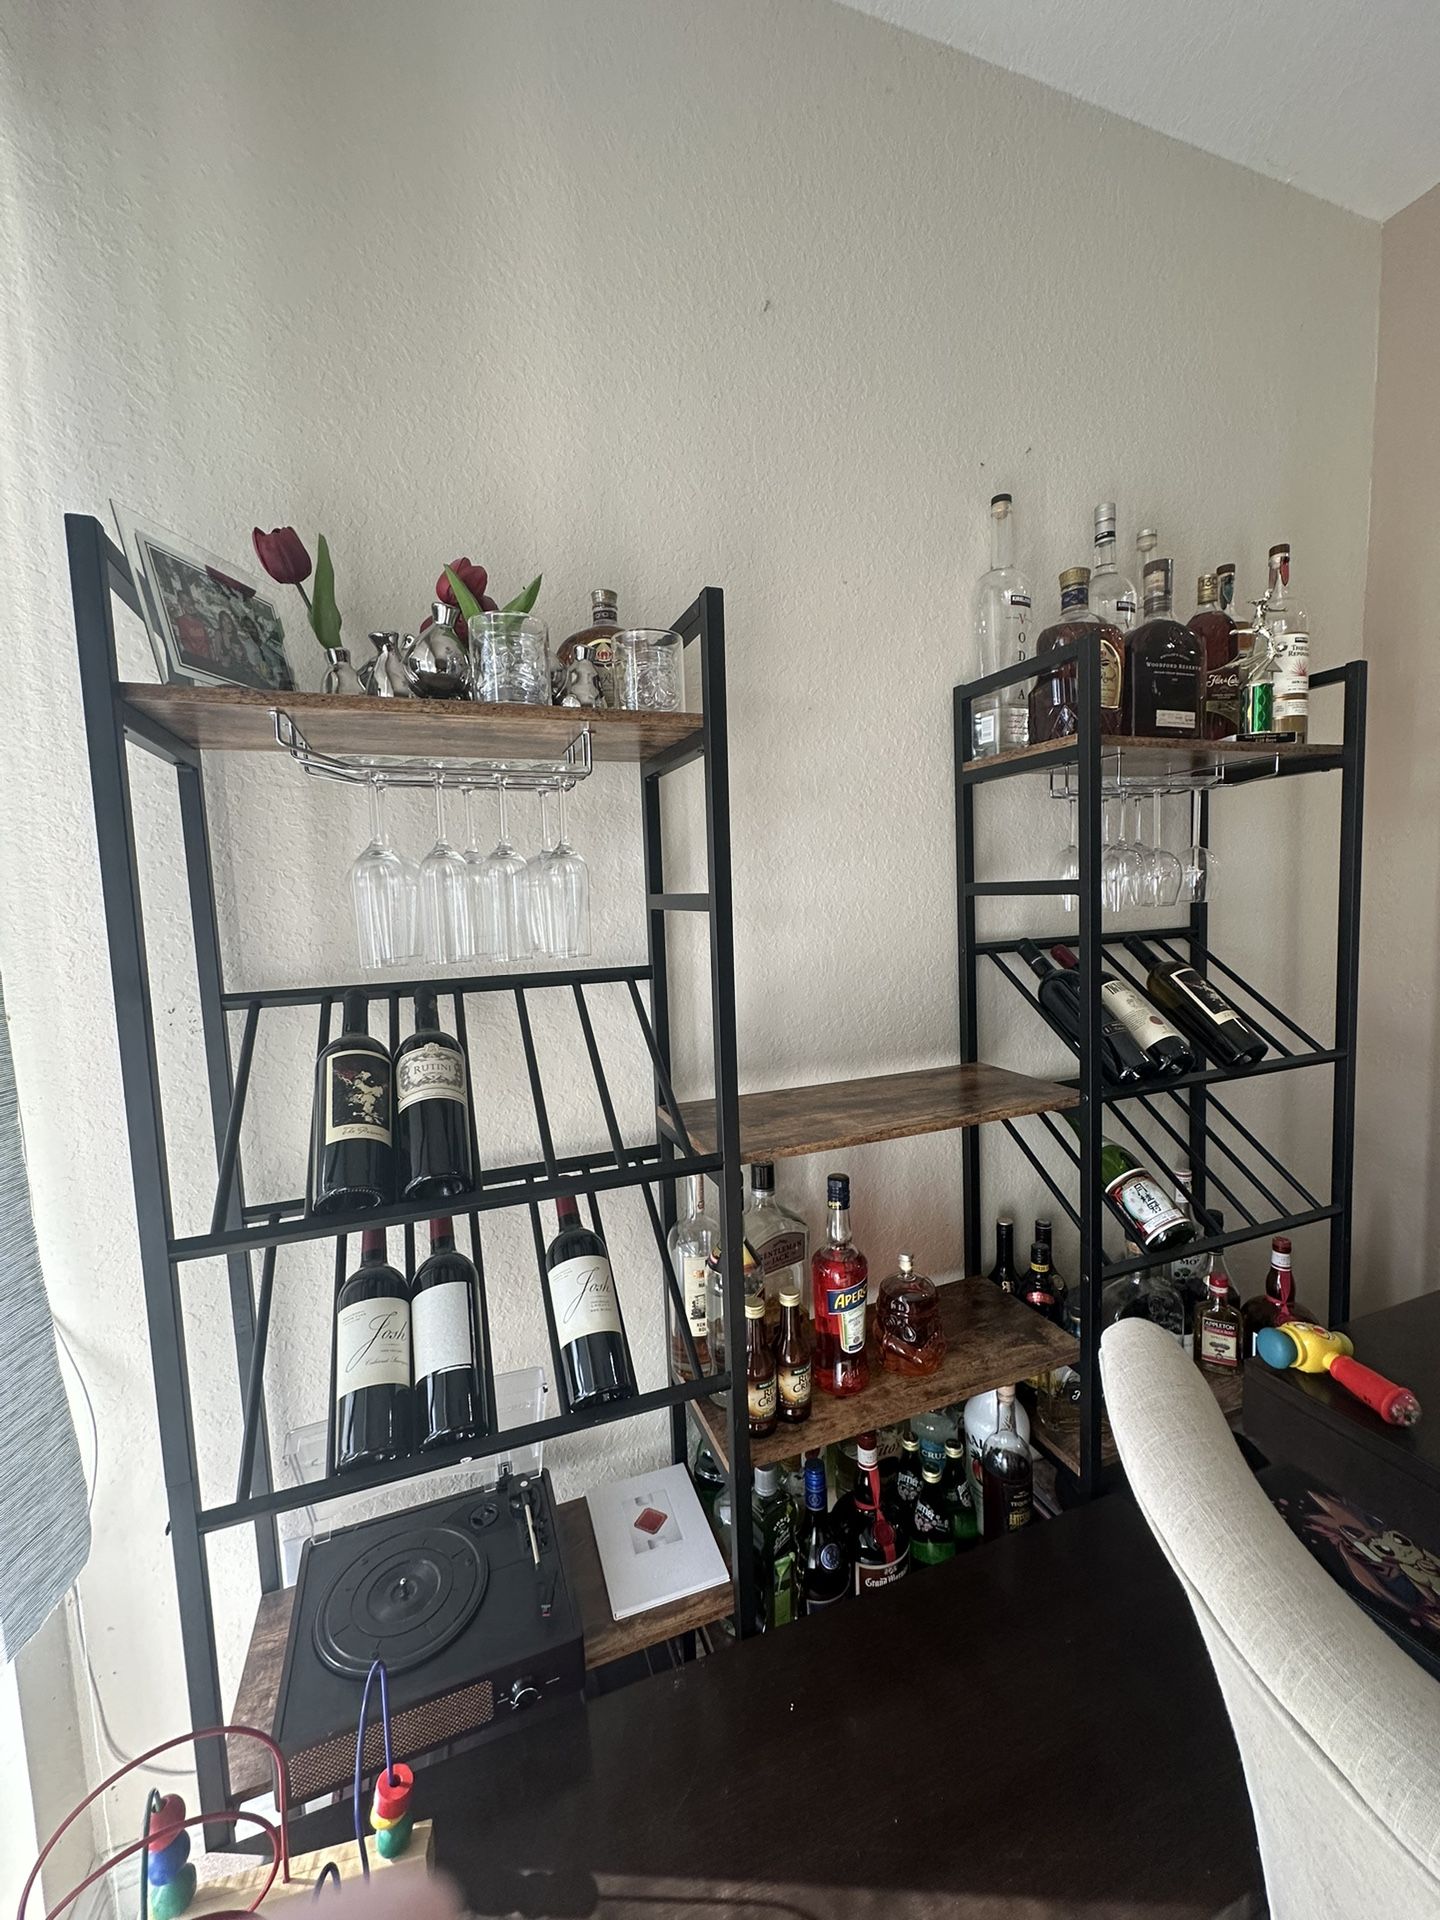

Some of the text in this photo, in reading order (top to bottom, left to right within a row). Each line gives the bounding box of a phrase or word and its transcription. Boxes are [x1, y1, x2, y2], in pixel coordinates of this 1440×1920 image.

[413, 1063, 451, 1074] RUTINI
[562, 1266, 611, 1324] Josh
[345, 1306, 408, 1373] Josh
[1205, 1320, 1236, 1330] APPLETON
